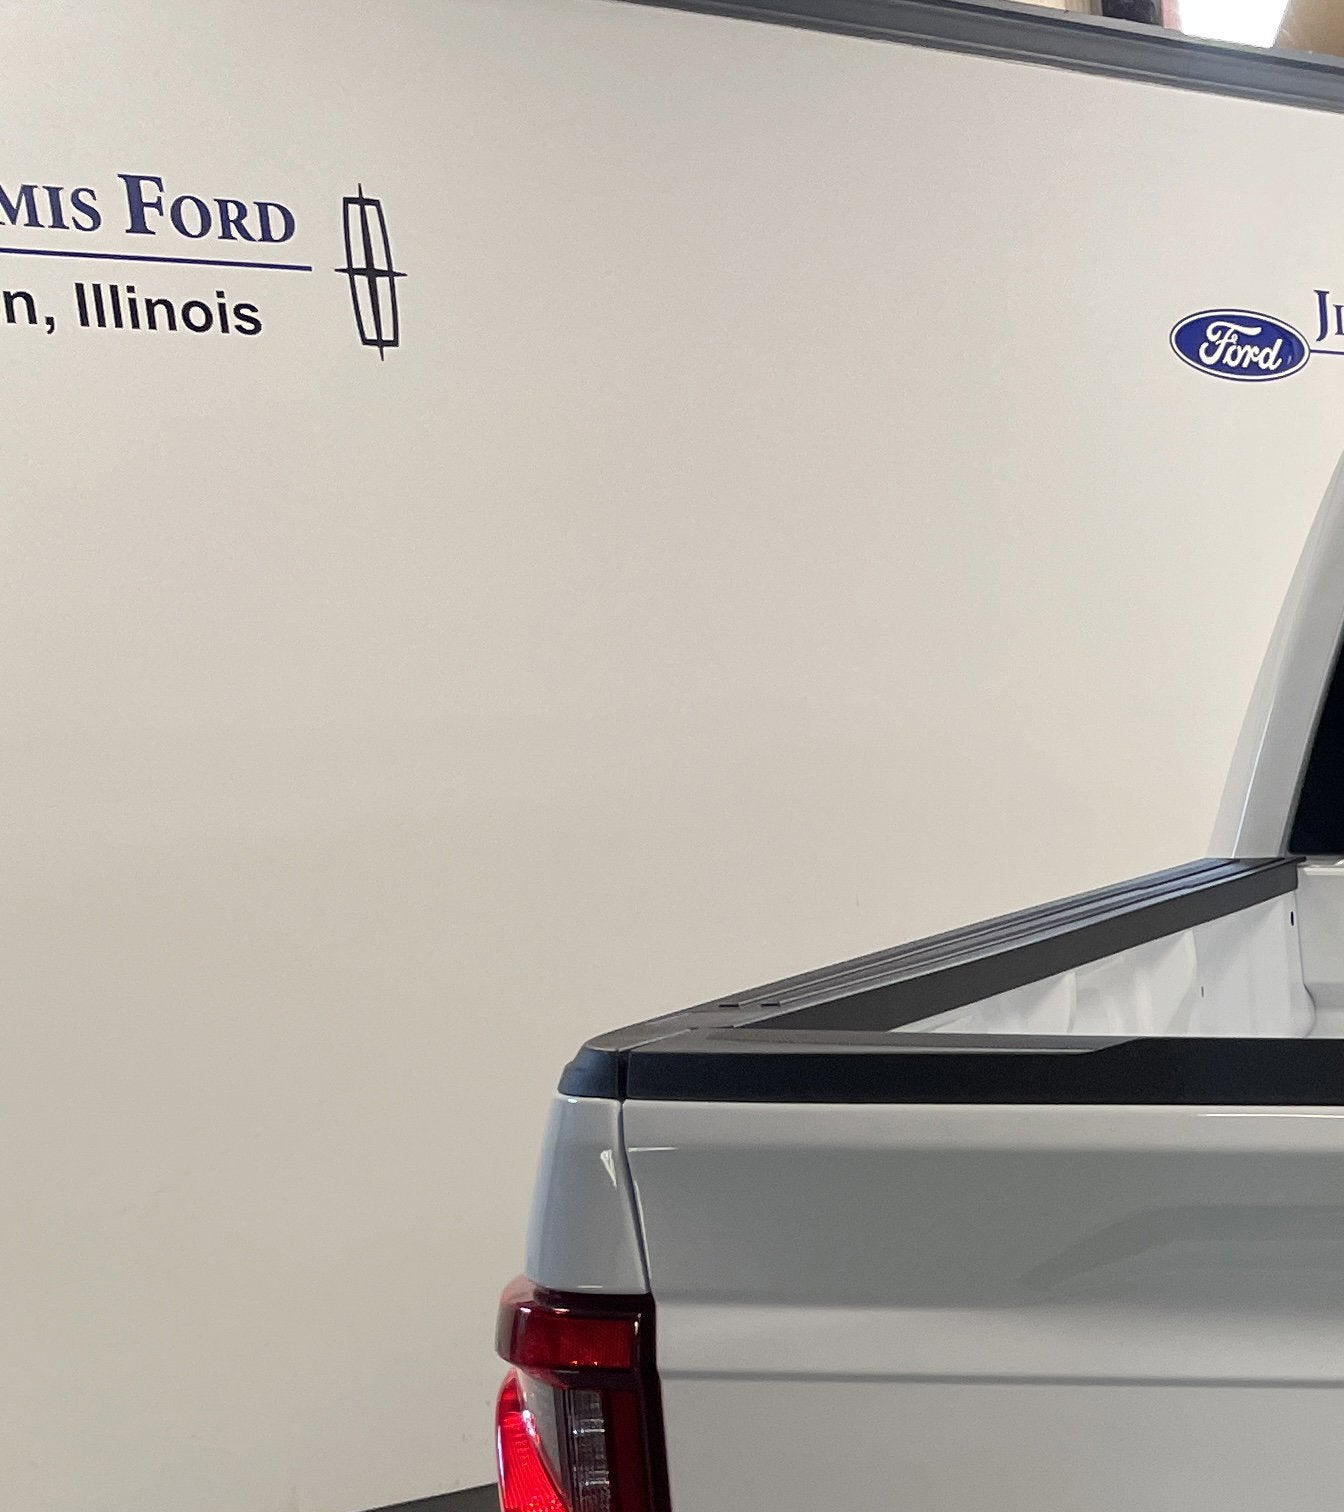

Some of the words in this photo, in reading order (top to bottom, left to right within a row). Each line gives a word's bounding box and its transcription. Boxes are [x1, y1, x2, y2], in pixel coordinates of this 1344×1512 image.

[0, 184, 101, 232] MIS
[118, 174, 295, 243] FORD
[75, 283, 262, 335] Illinois
[1198, 319, 1282, 371] Ford
